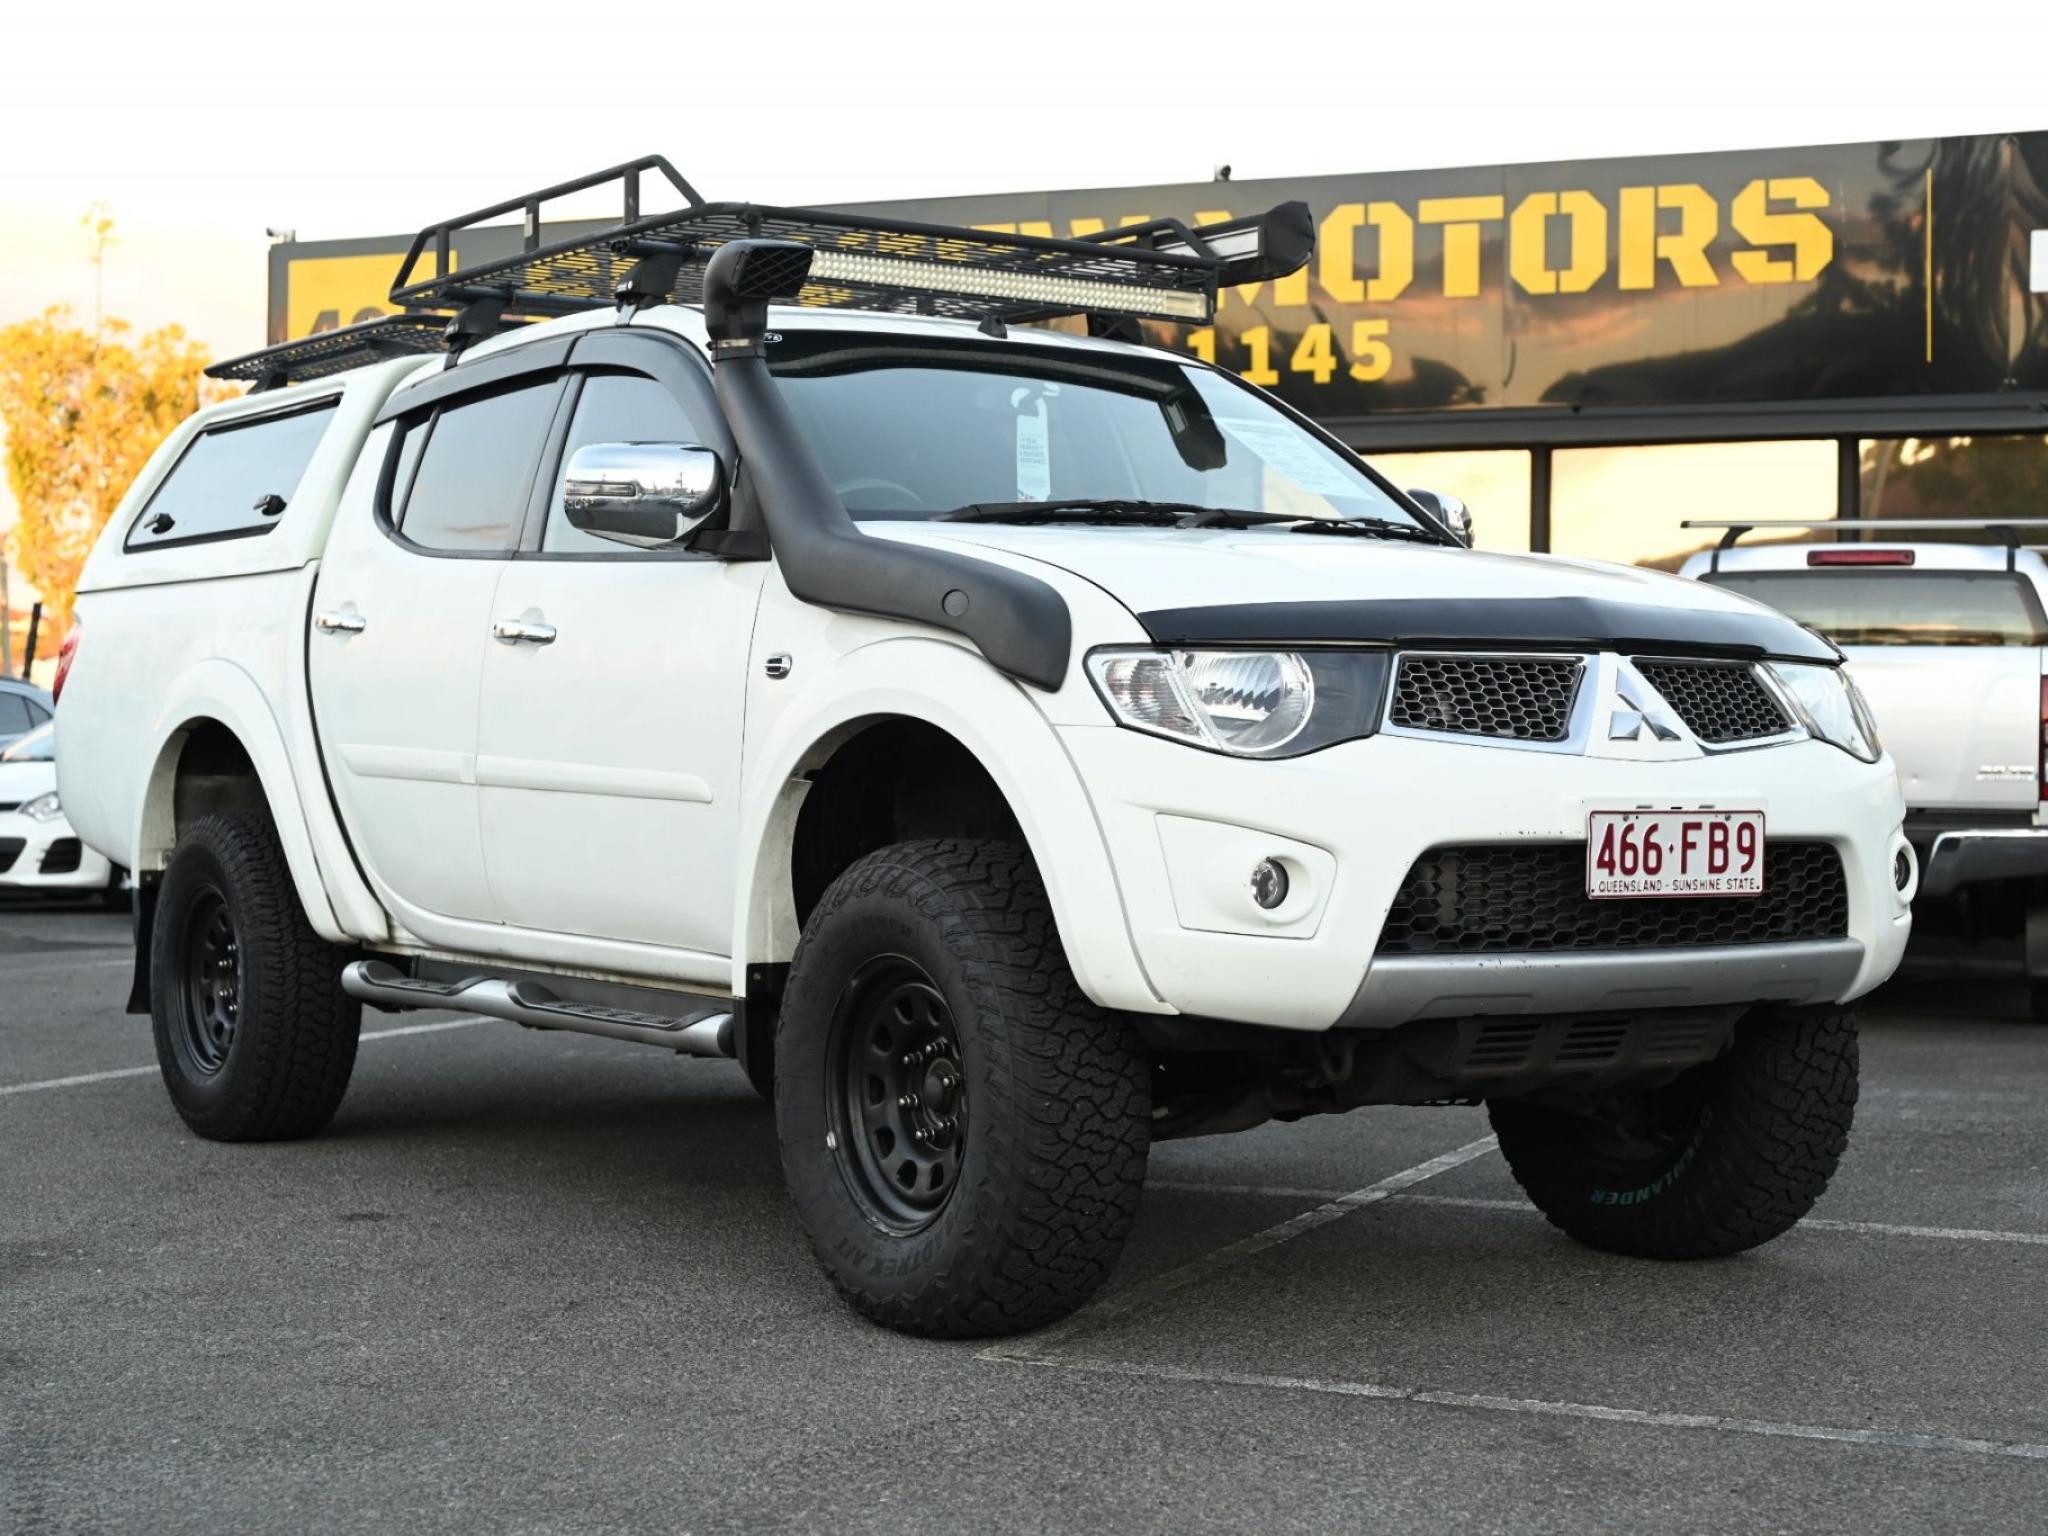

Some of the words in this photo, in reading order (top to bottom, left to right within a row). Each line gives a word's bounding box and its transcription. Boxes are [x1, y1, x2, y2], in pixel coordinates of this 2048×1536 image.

[1187, 319, 1393, 386] 1145
[1599, 879, 1662, 893] QUEENSLAND
[1672, 878, 1721, 891] SUNSHINE
[1726, 877, 1755, 890] STATE
